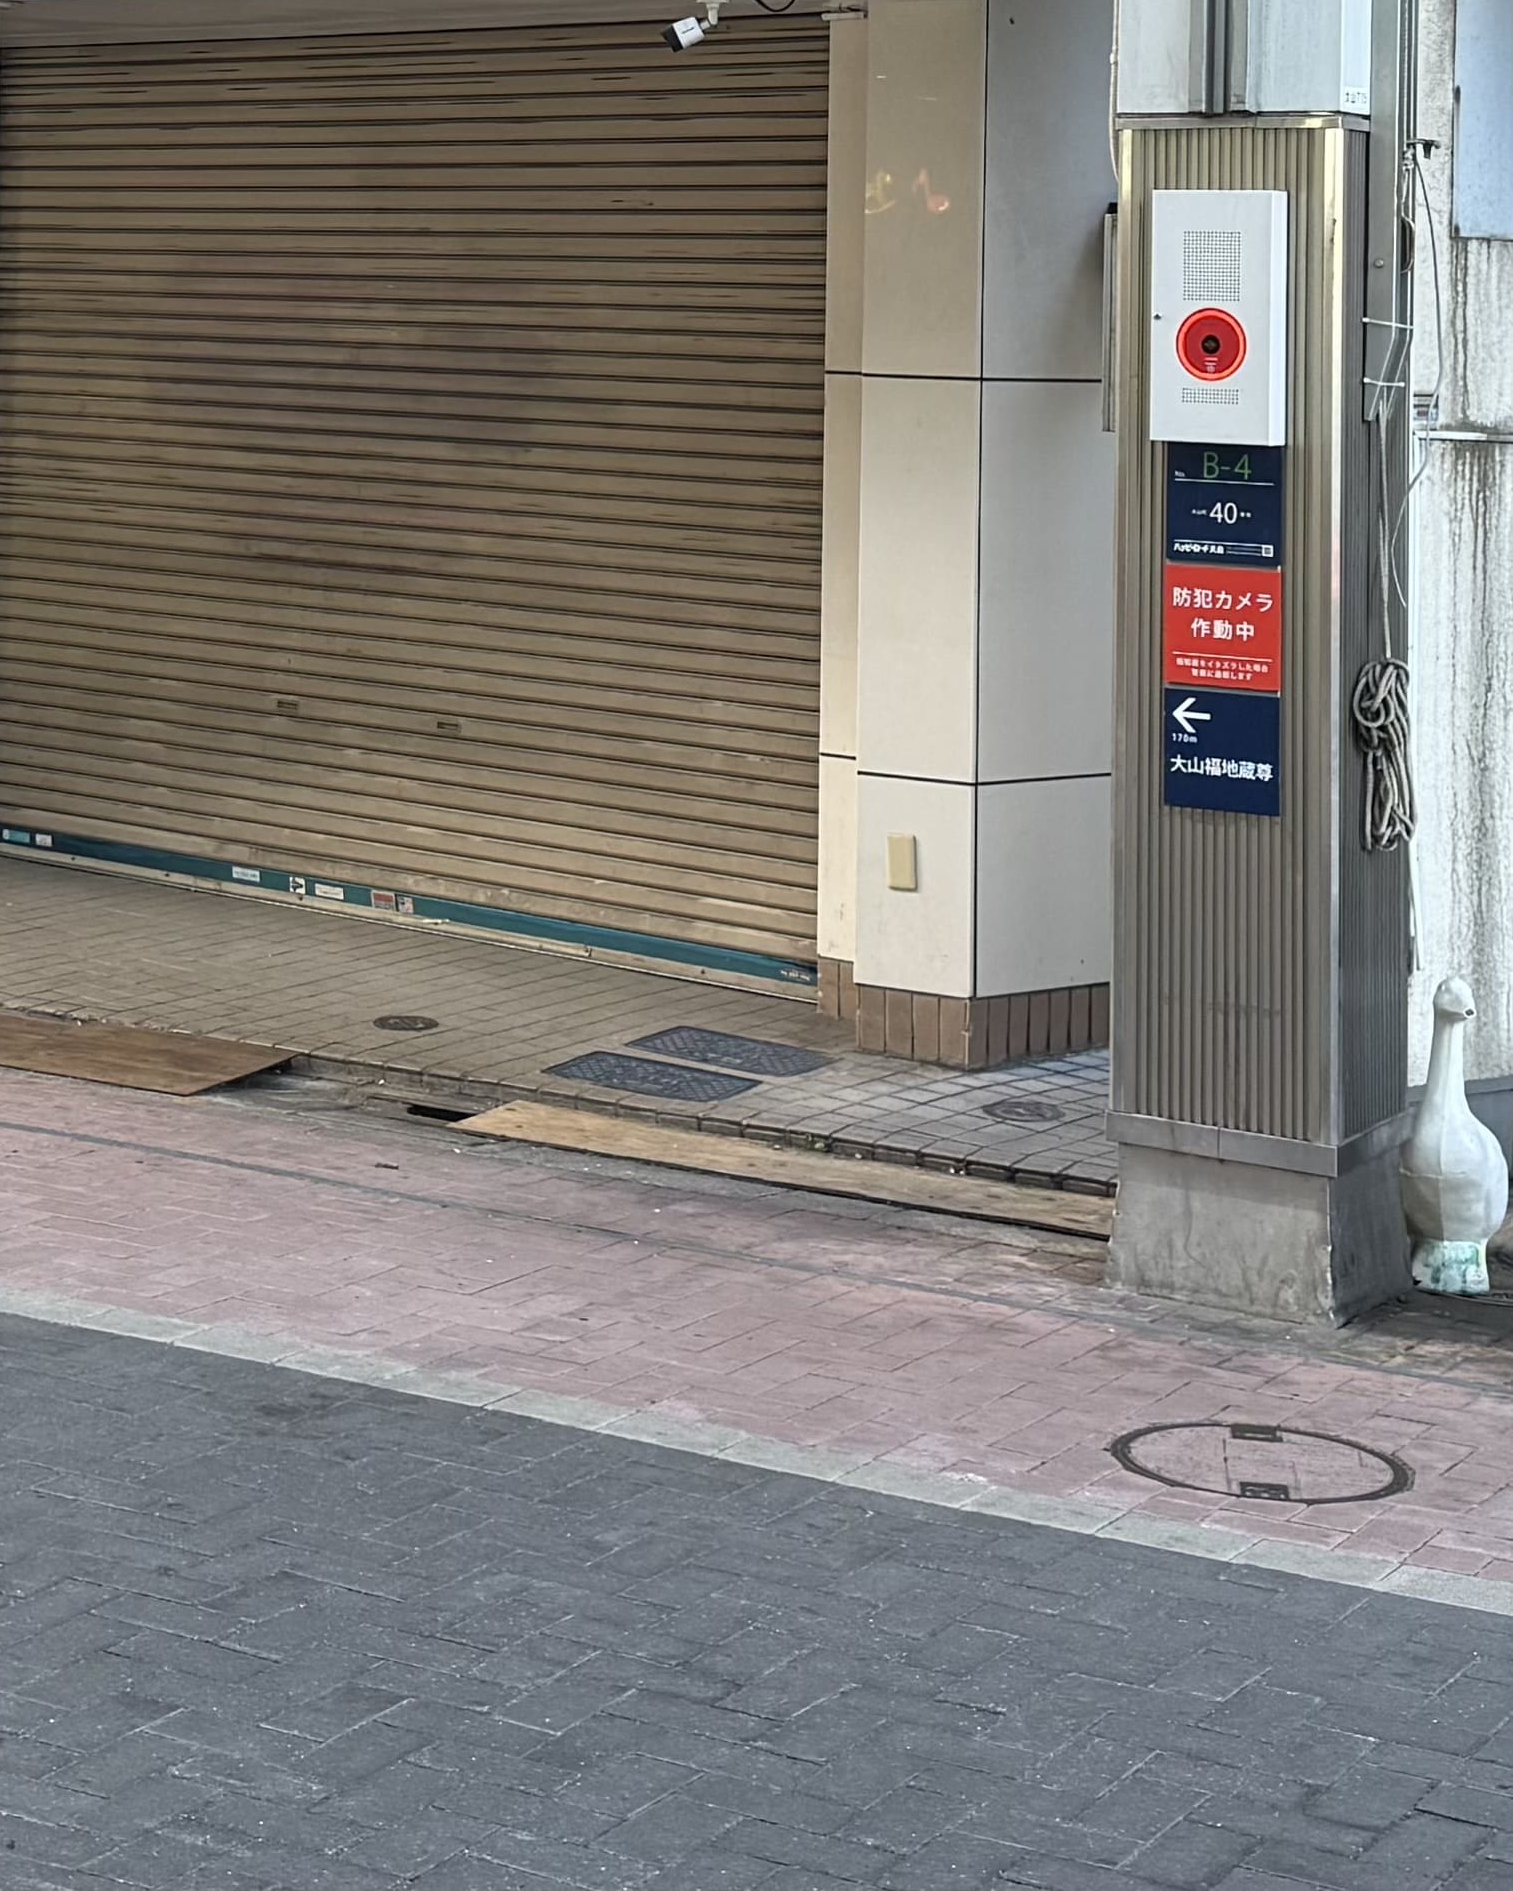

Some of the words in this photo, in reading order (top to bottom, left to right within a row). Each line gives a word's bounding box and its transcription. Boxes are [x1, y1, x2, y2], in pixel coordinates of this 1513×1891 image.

[1203, 451, 1252, 480] B-4
[1209, 501, 1238, 525] 40
[1172, 586, 1274, 613] 防犯カメラ
[1190, 617, 1255, 642] 作動中
[1172, 732, 1198, 744] 170m
[1170, 754, 1274, 783] 大山福地蔵尊
